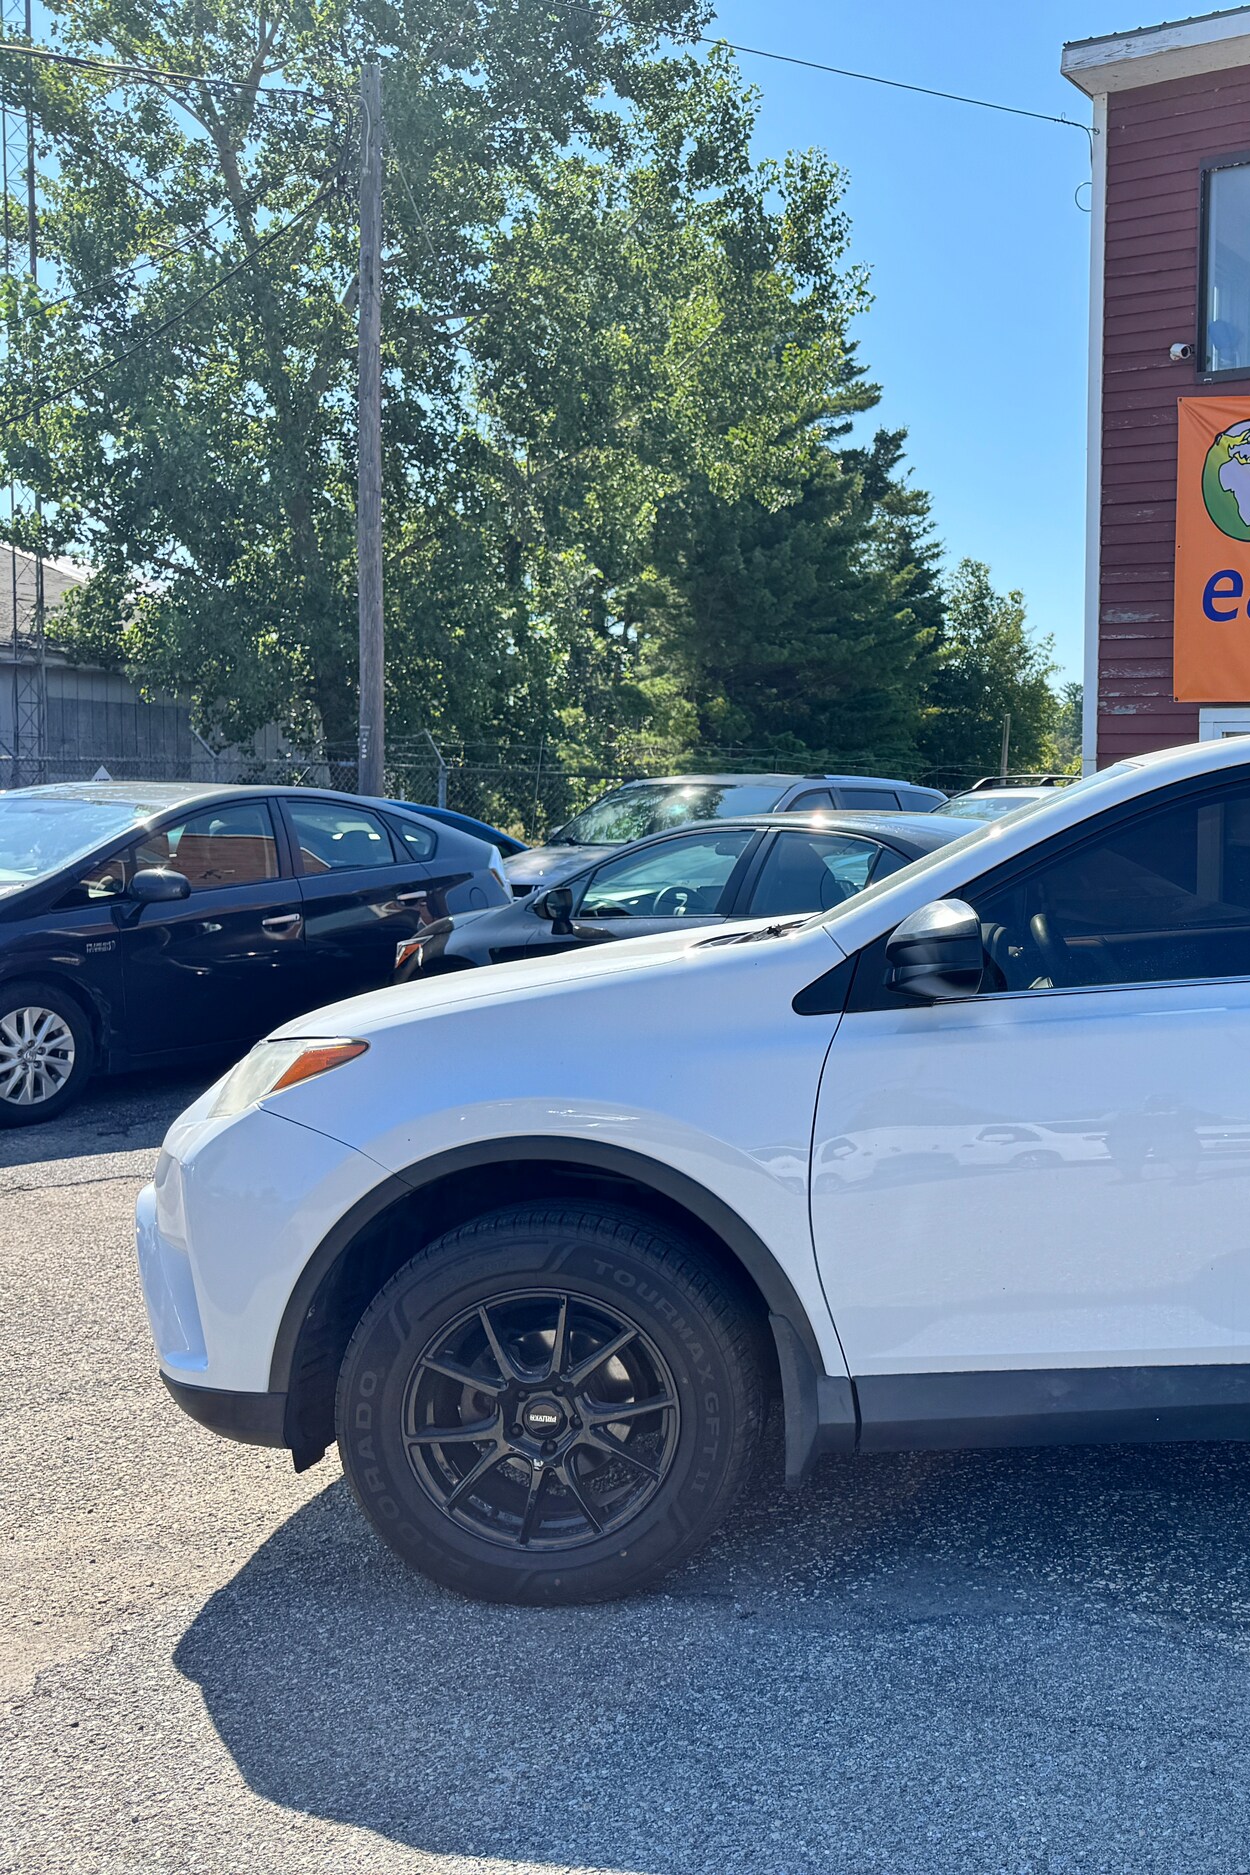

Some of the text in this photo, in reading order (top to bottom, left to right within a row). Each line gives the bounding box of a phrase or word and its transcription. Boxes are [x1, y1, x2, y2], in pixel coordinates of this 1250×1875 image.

[592, 1258, 716, 1386] TOURMAX
[702, 1391, 721, 1460] GFT
[355, 1368, 472, 1577] ELDORADO
